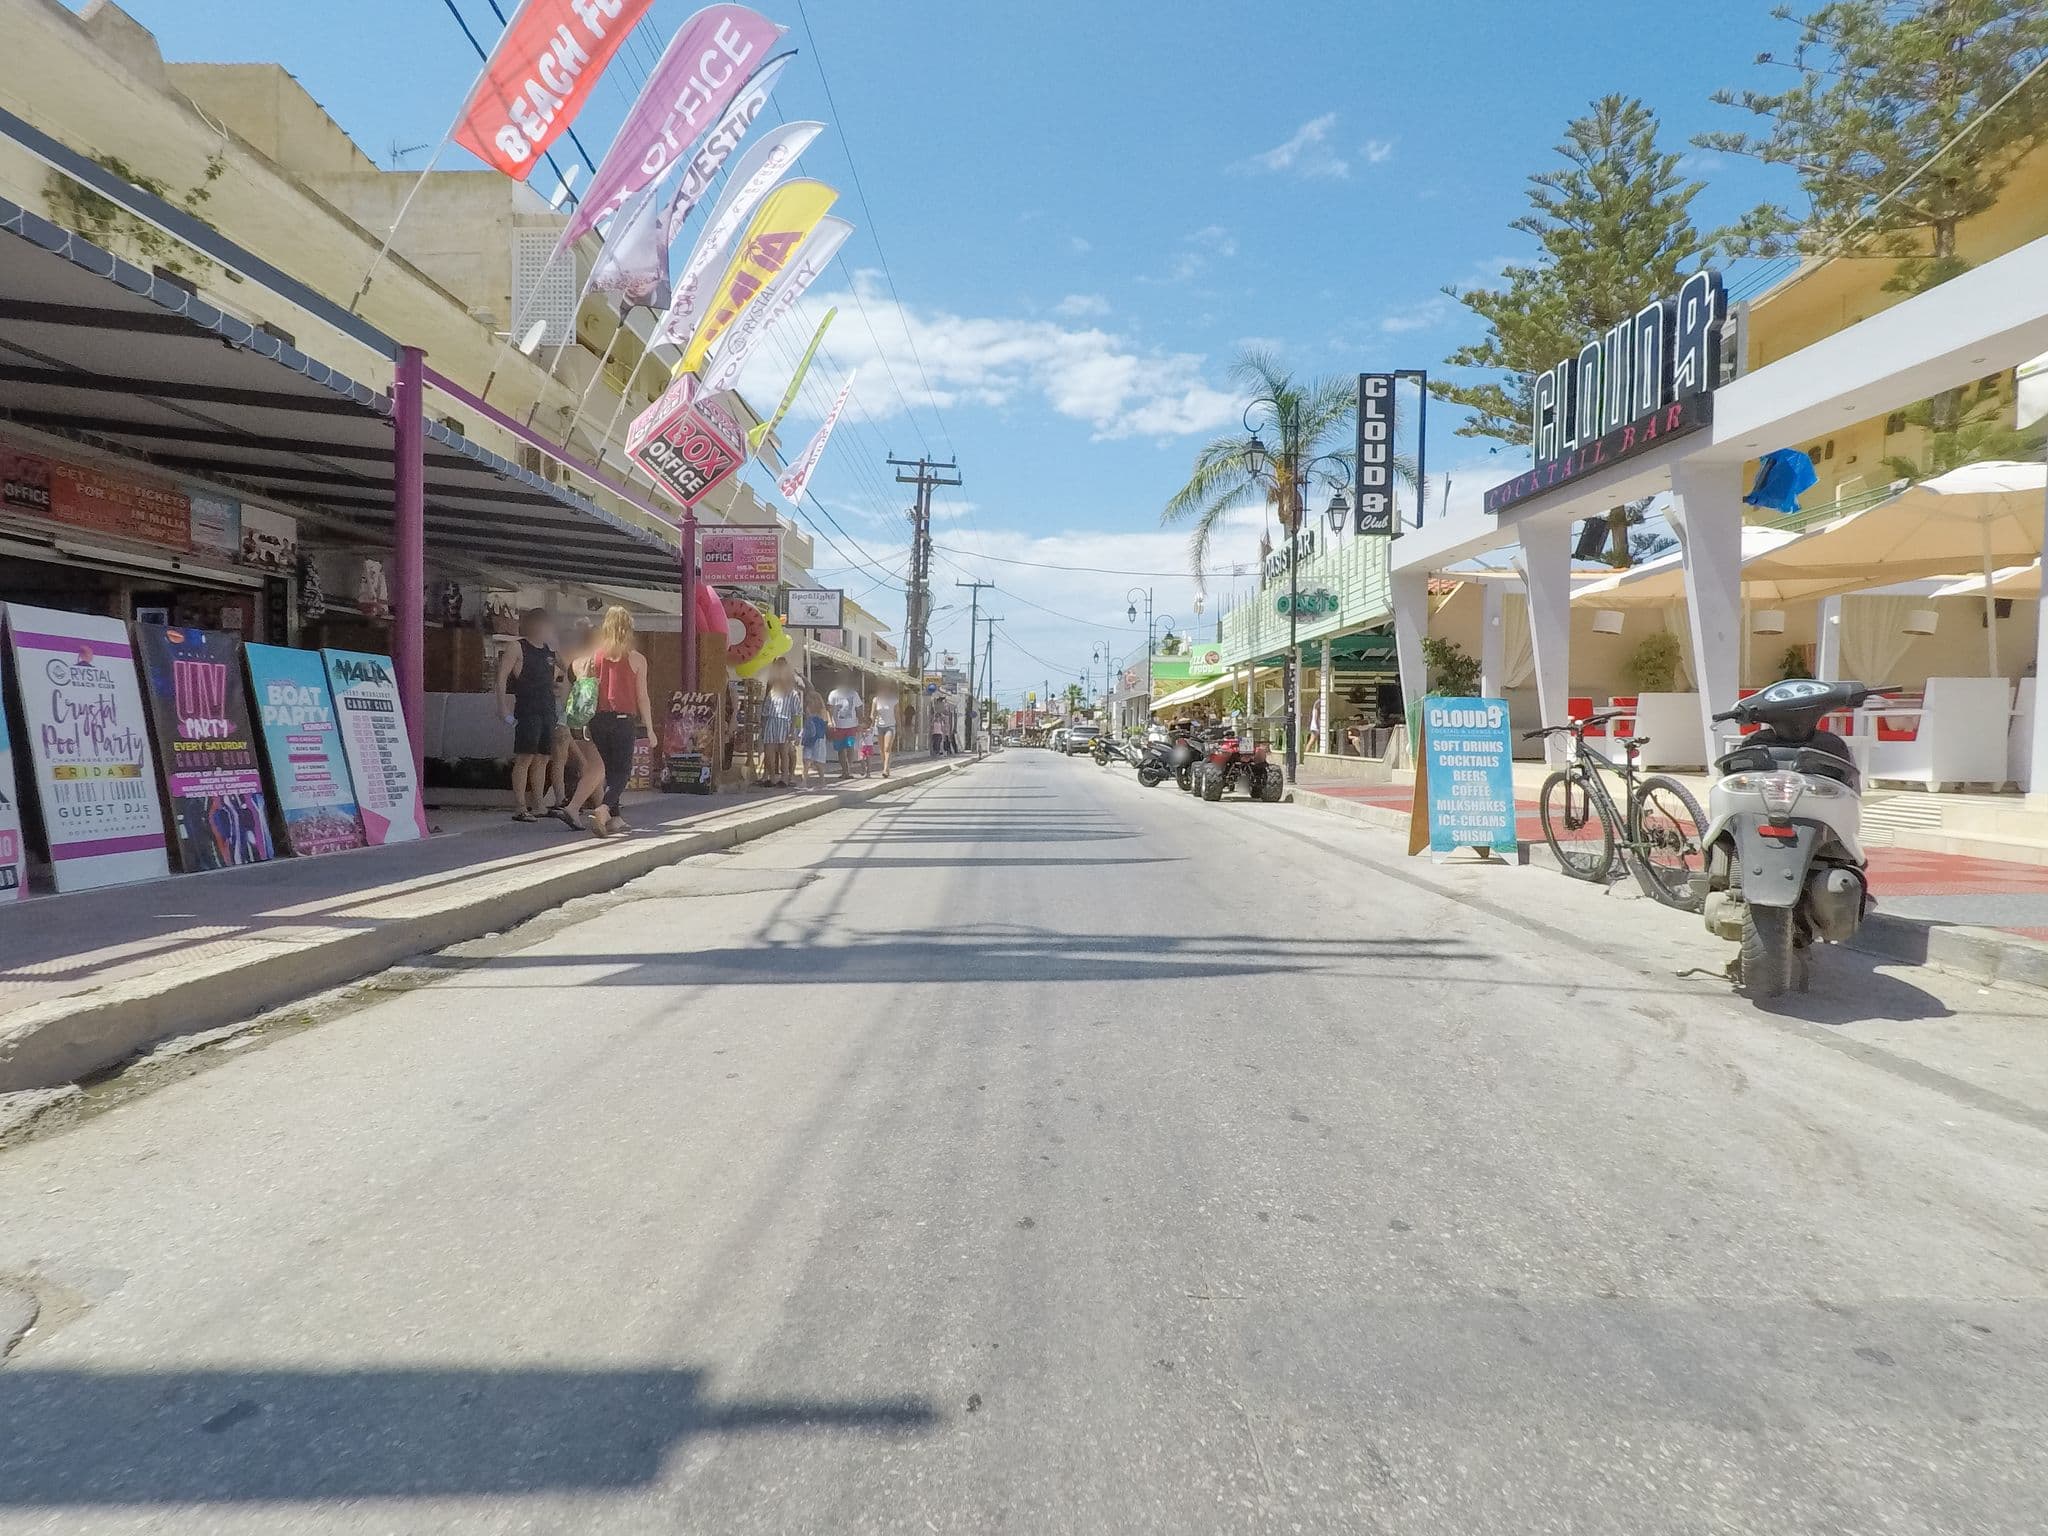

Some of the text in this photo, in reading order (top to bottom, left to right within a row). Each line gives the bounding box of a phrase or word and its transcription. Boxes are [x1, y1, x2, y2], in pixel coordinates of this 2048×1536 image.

[495, 24, 590, 163] BEACH
[1533, 300, 1672, 470] CLOUD
[1363, 377, 1389, 486] CLOUD
[662, 413, 731, 480] BOX
[1488, 404, 1682, 511] COCKTAIL BAR
[648, 441, 704, 493] OFFICE
[4, 482, 51, 506] OFFICE
[78, 482, 106, 500] FOR
[135, 486, 188, 508] TICKETS
[149, 511, 187, 530] MALIA
[1361, 514, 1389, 531] Club
[705, 553, 733, 563] OFFICE
[266, 685, 322, 706] BOAT
[673, 690, 715, 705] PAINT
[52, 689, 118, 737] Crystal
[262, 705, 330, 728] PARTY
[671, 703, 712, 718] PARTY
[185, 718, 229, 740] PARTY
[42, 719, 144, 769] Pool Party
[173, 741, 248, 752] EVERY SATURDAY
[1433, 740, 1504, 753] SOFT DRINKS
[1439, 755, 1499, 768] COCKTAILS
[1453, 770, 1488, 783] BEERS
[1451, 784, 1492, 798] COFFEE
[58, 803, 150, 819] GUEST DJs
[1437, 799, 1506, 814] MILKSHAKES
[1438, 813, 1506, 828] ICE-CREAMS
[1452, 829, 1494, 843] SHISHA
